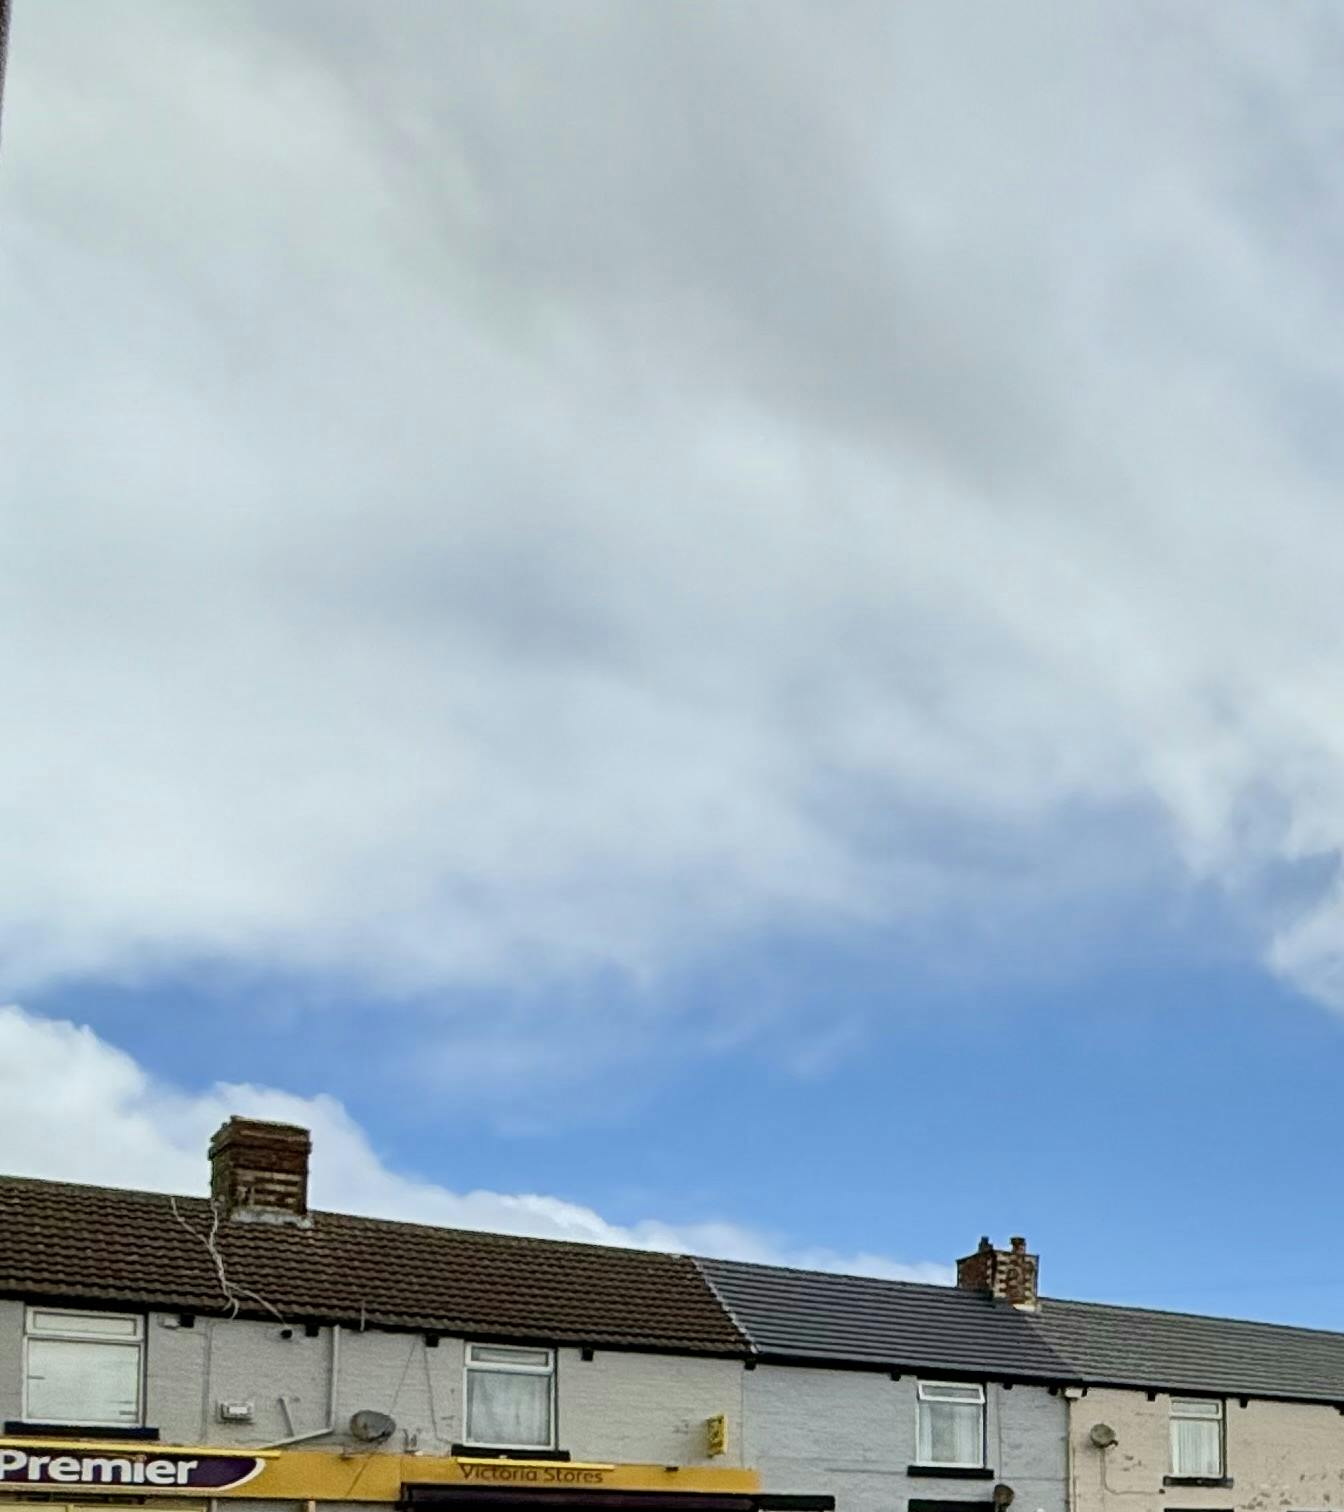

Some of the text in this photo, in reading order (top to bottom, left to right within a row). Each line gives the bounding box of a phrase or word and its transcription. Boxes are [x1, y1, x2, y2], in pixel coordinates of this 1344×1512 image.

[0, 1449, 199, 1485] Premier
[459, 1463, 604, 1483] Victoria Stores
